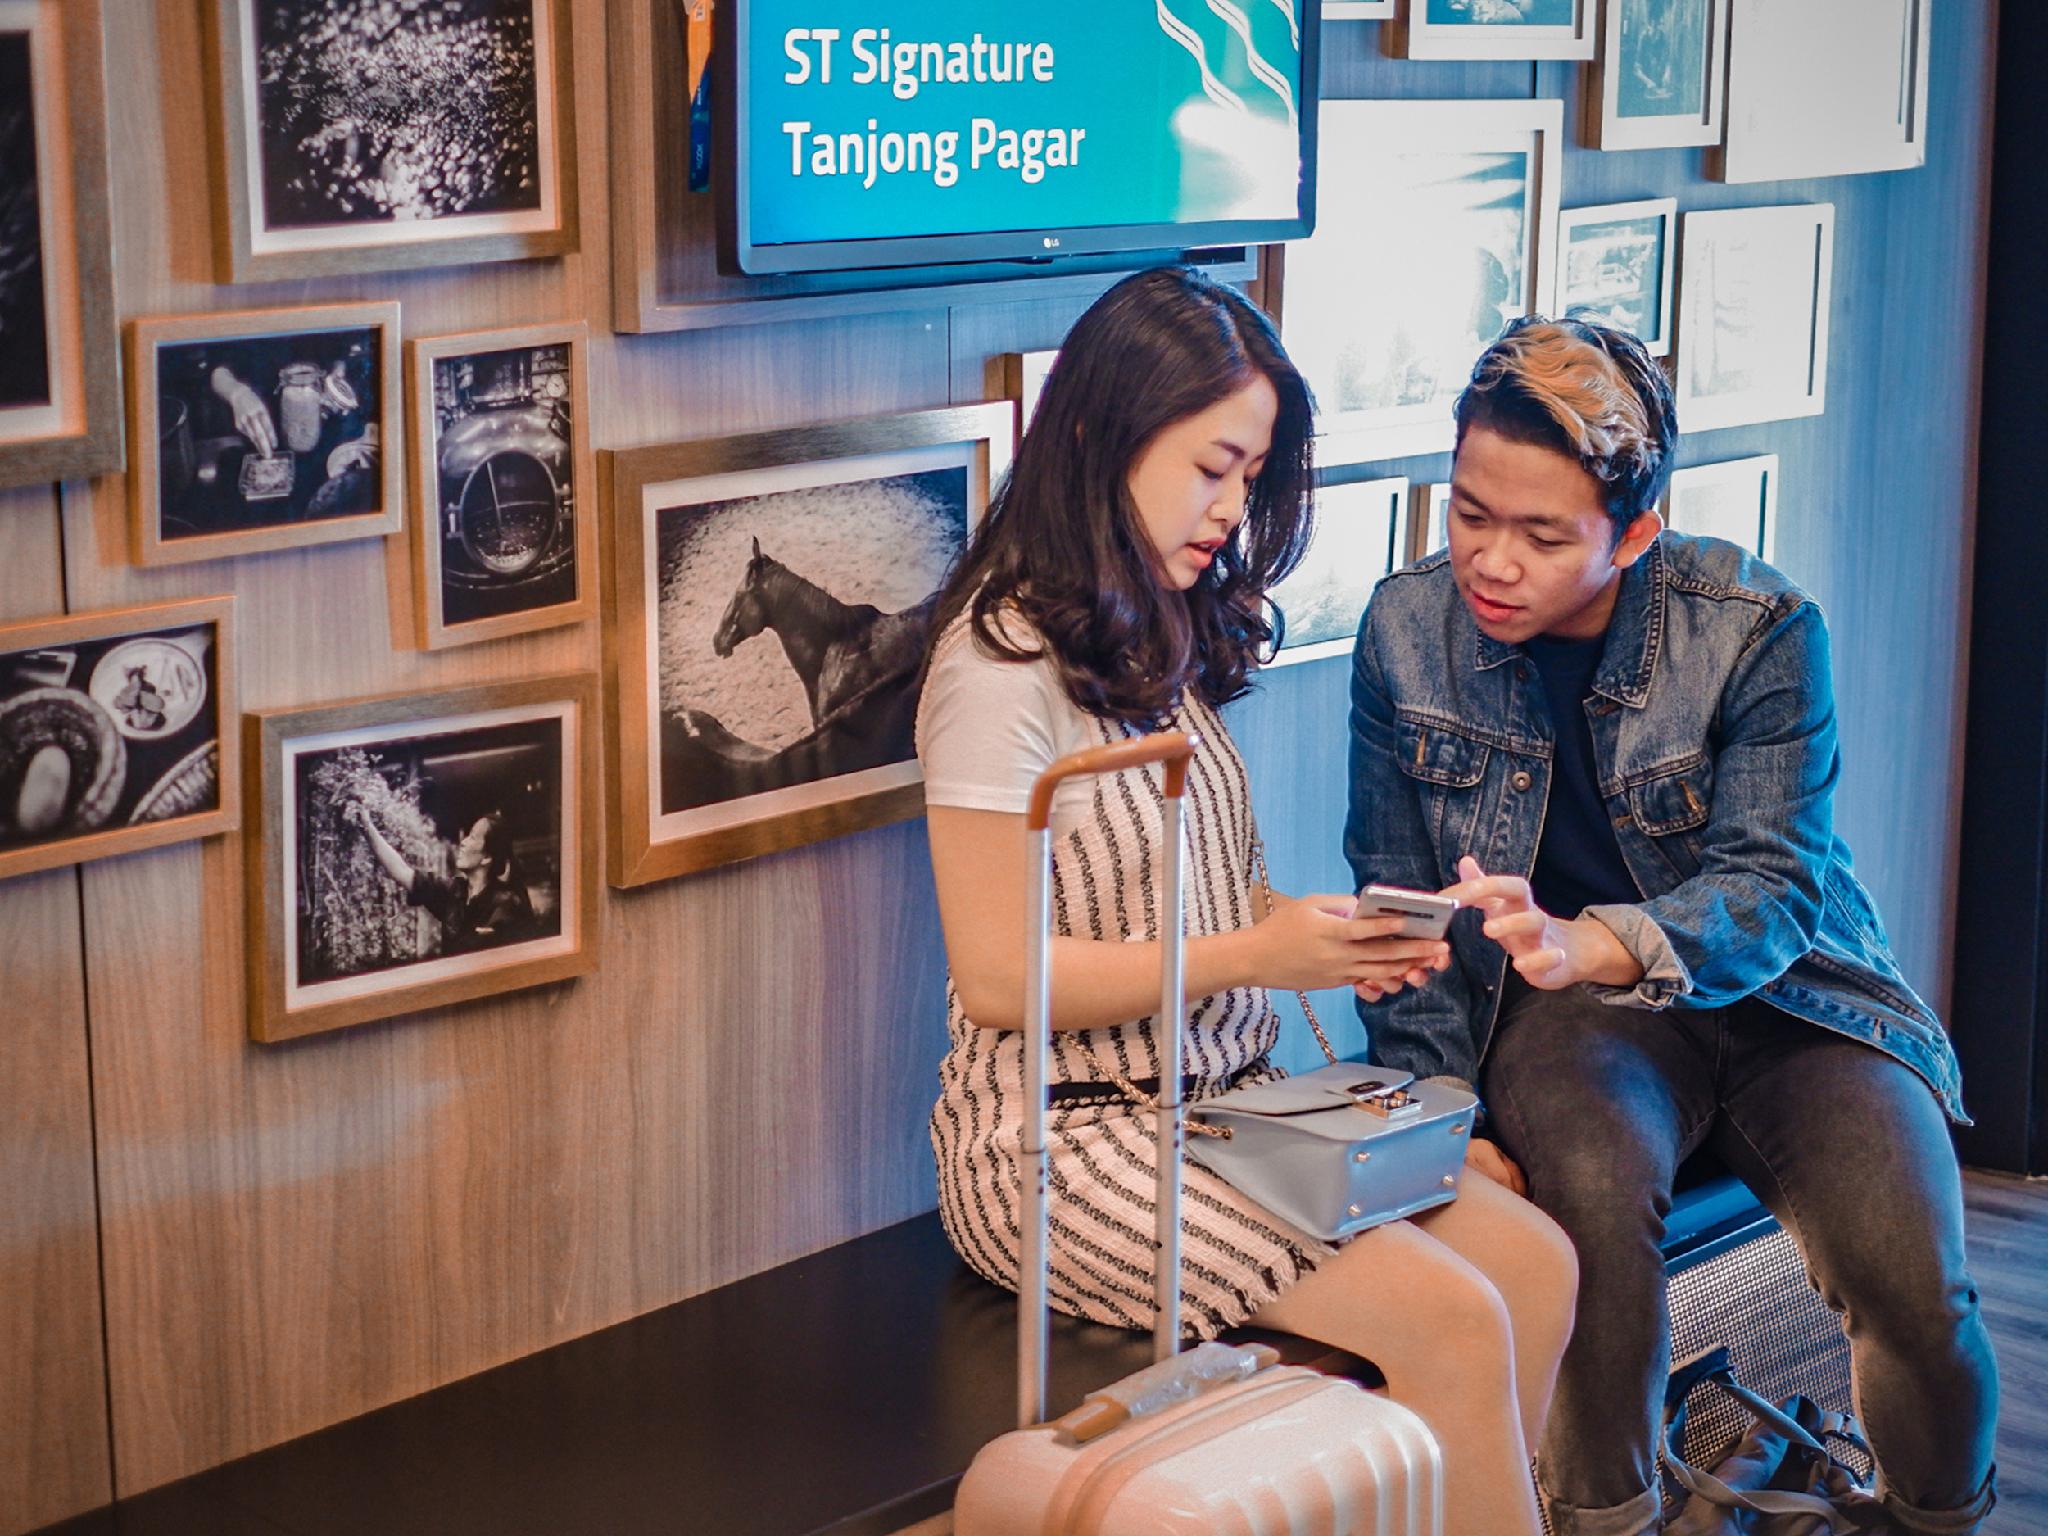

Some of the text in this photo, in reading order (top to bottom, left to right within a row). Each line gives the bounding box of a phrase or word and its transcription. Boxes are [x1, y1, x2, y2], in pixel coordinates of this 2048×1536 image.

[784, 28, 1054, 100] ST Signature
[782, 118, 1086, 190] Tanjong Pagar
